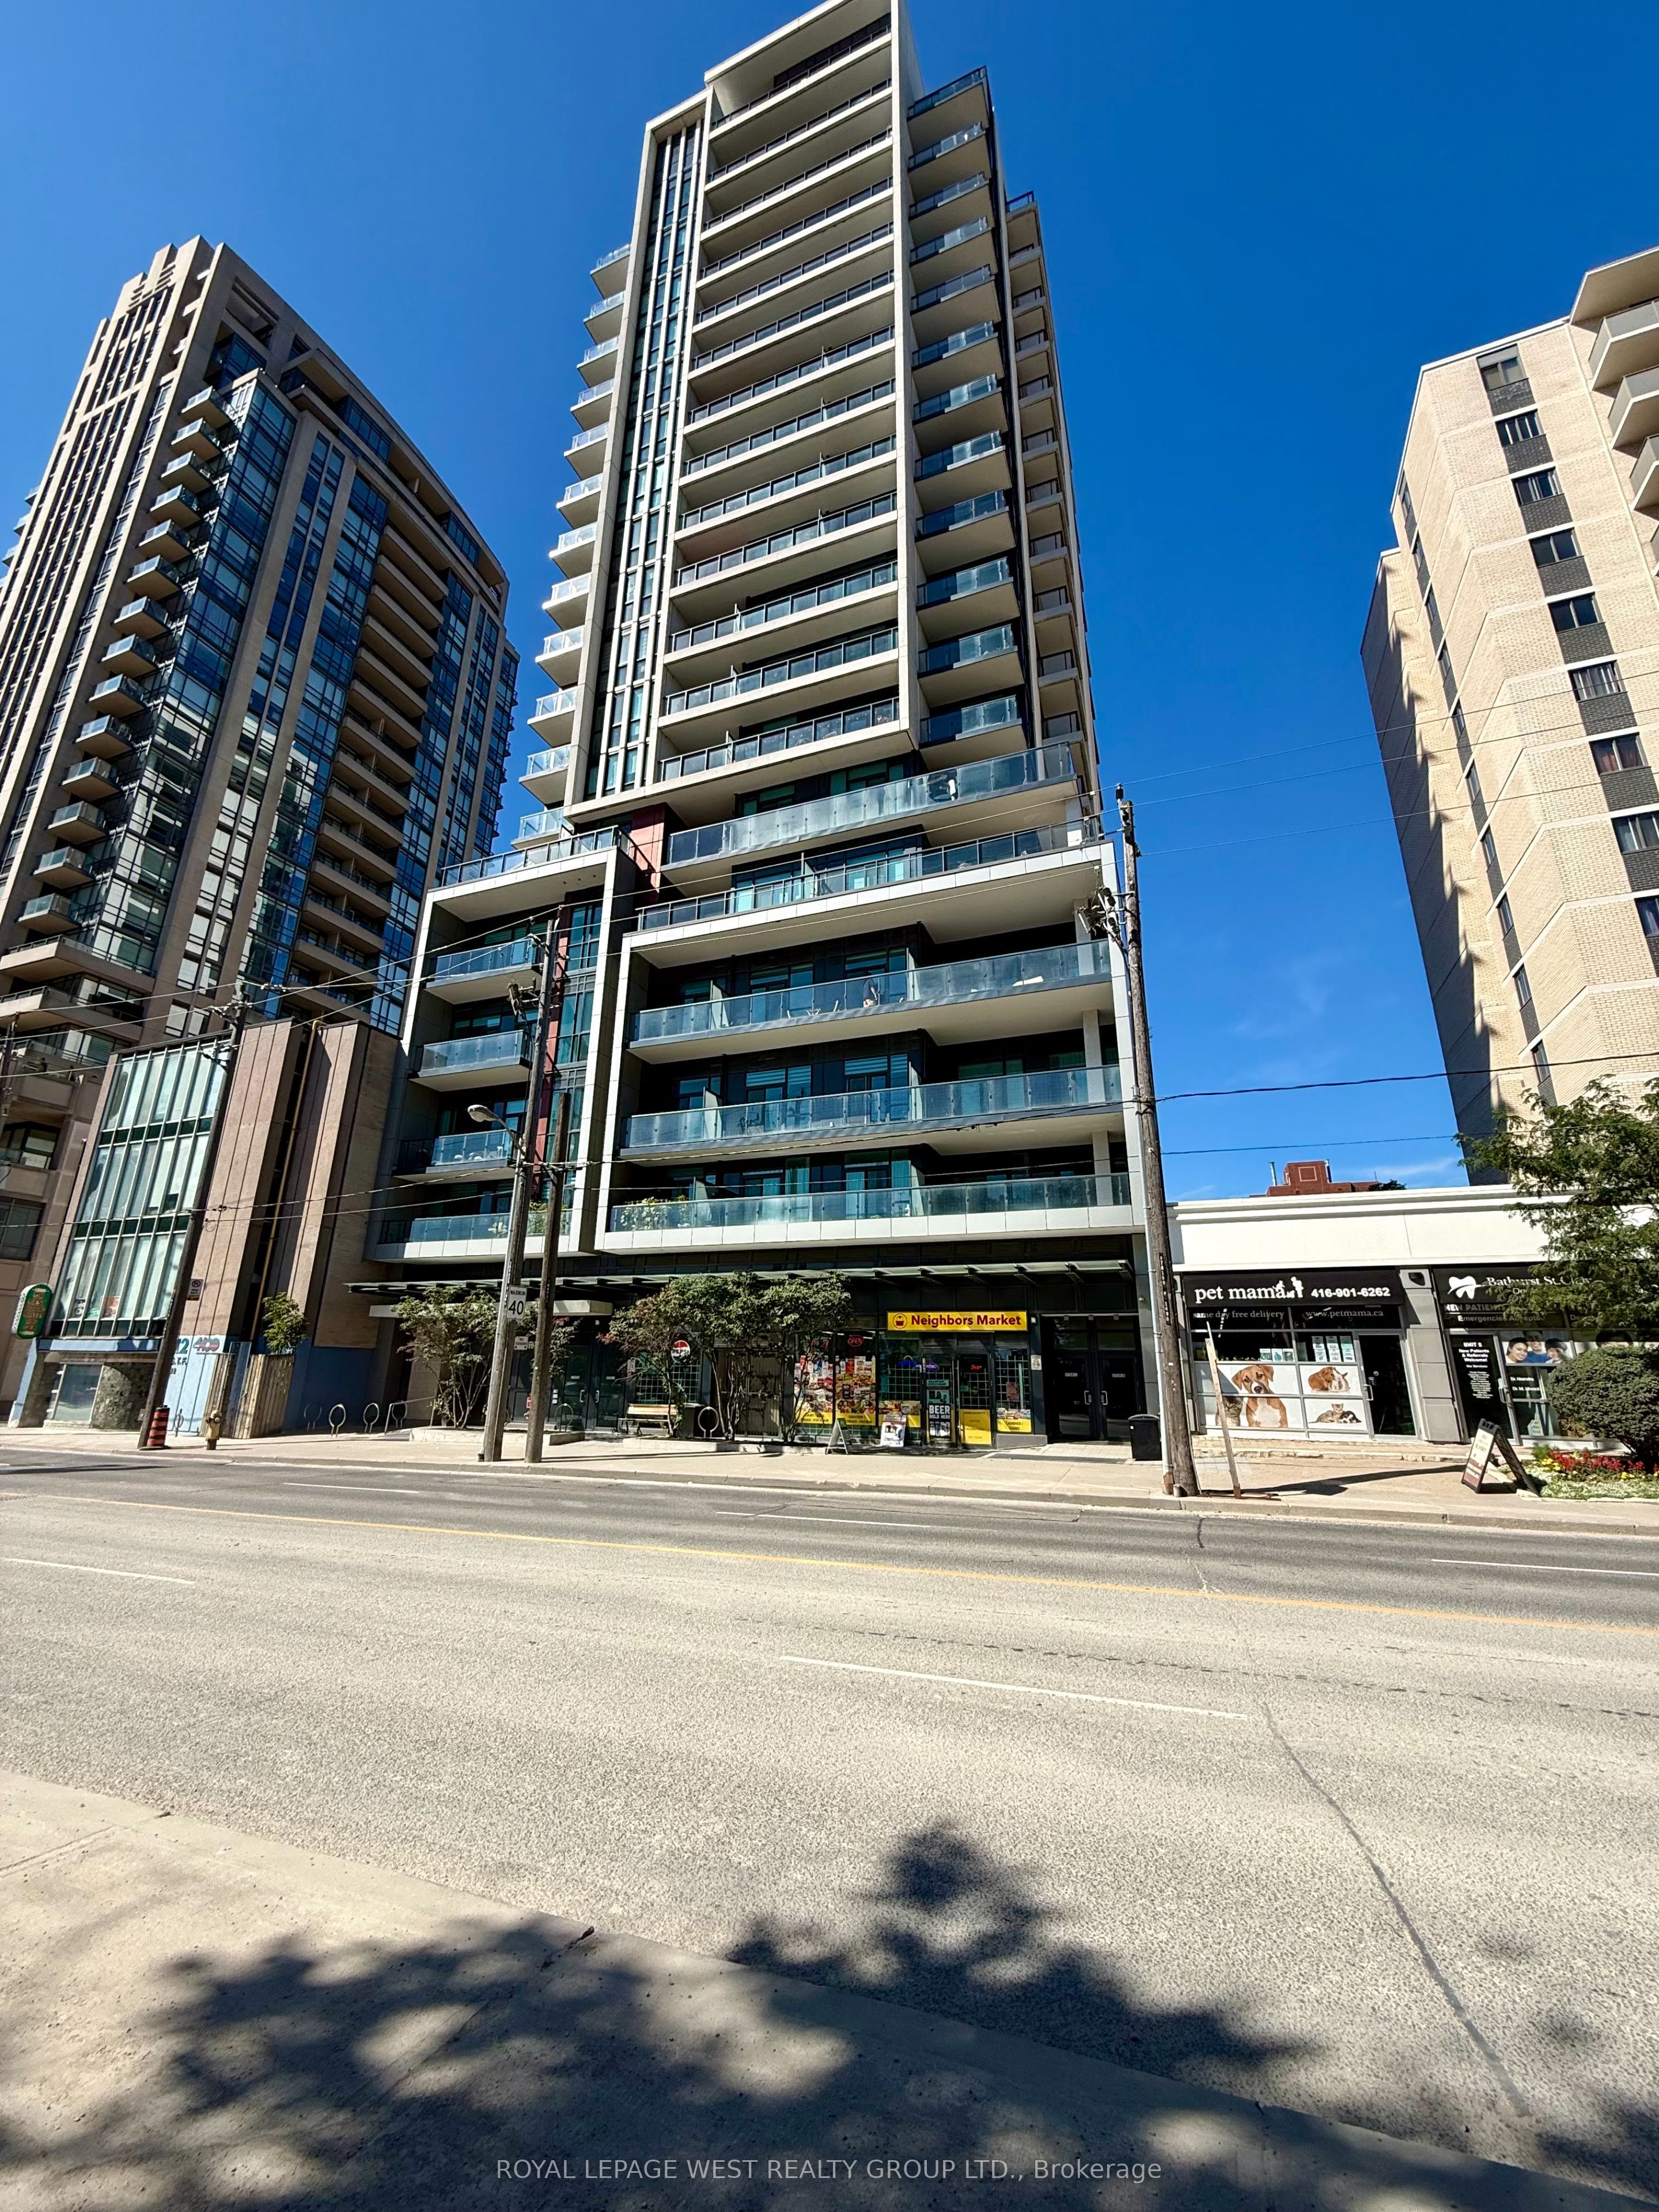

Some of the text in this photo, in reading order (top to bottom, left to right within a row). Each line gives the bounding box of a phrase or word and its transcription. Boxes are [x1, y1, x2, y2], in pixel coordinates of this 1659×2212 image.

[1194, 1286, 1289, 1304] pet mama
[1311, 1287, 1391, 1297] 416-901-6262
[509, 1300, 524, 1315] 40
[1215, 1310, 1229, 1319] day
[1250, 1310, 1284, 1319] delivery
[1305, 1310, 1384, 1318] www.petmama.ca
[911, 1314, 1021, 1328] Neighbors Market
[929, 1404, 950, 1414] BEER
